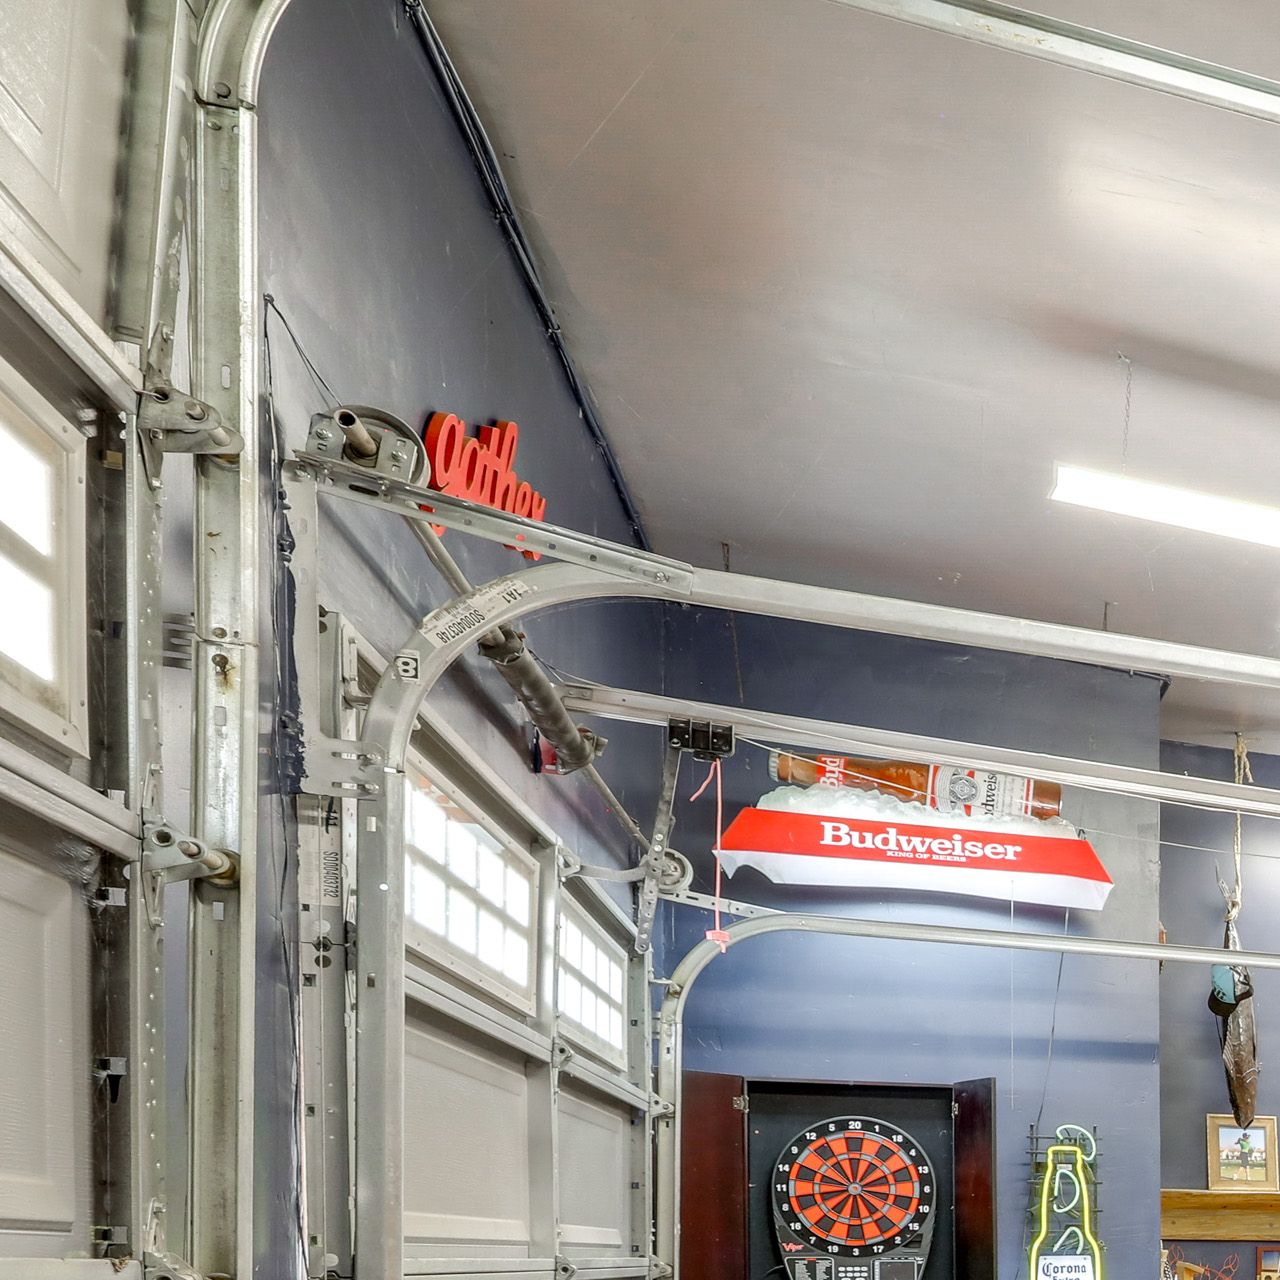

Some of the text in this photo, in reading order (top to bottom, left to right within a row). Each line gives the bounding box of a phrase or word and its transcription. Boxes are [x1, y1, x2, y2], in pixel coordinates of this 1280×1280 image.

[820, 822, 1022, 861] Budweiser
[886, 850, 967, 862] KING OF BEERS
[829, 1123, 835, 1131] 5
[849, 1121, 861, 1129] 20
[874, 1125, 880, 1133] 1
[805, 1132, 816, 1140] 12
[892, 1135, 903, 1143] 18
[791, 1146, 798, 1154] 9
[909, 1149, 916, 1157] 4
[778, 1164, 789, 1172] 14
[918, 1166, 929, 1174] 13
[923, 1186, 931, 1194] 6
[918, 1205, 930, 1213] 10
[790, 1222, 802, 1230] 16
[908, 1222, 920, 1231] 15
[809, 1236, 816, 1244] 7
[782, 1242, 804, 1253] Viper
[827, 1245, 839, 1253] 19
[872, 1245, 884, 1253] 17
[852, 1248, 860, 1256] 3
[1042, 1262, 1088, 1278] Corona
